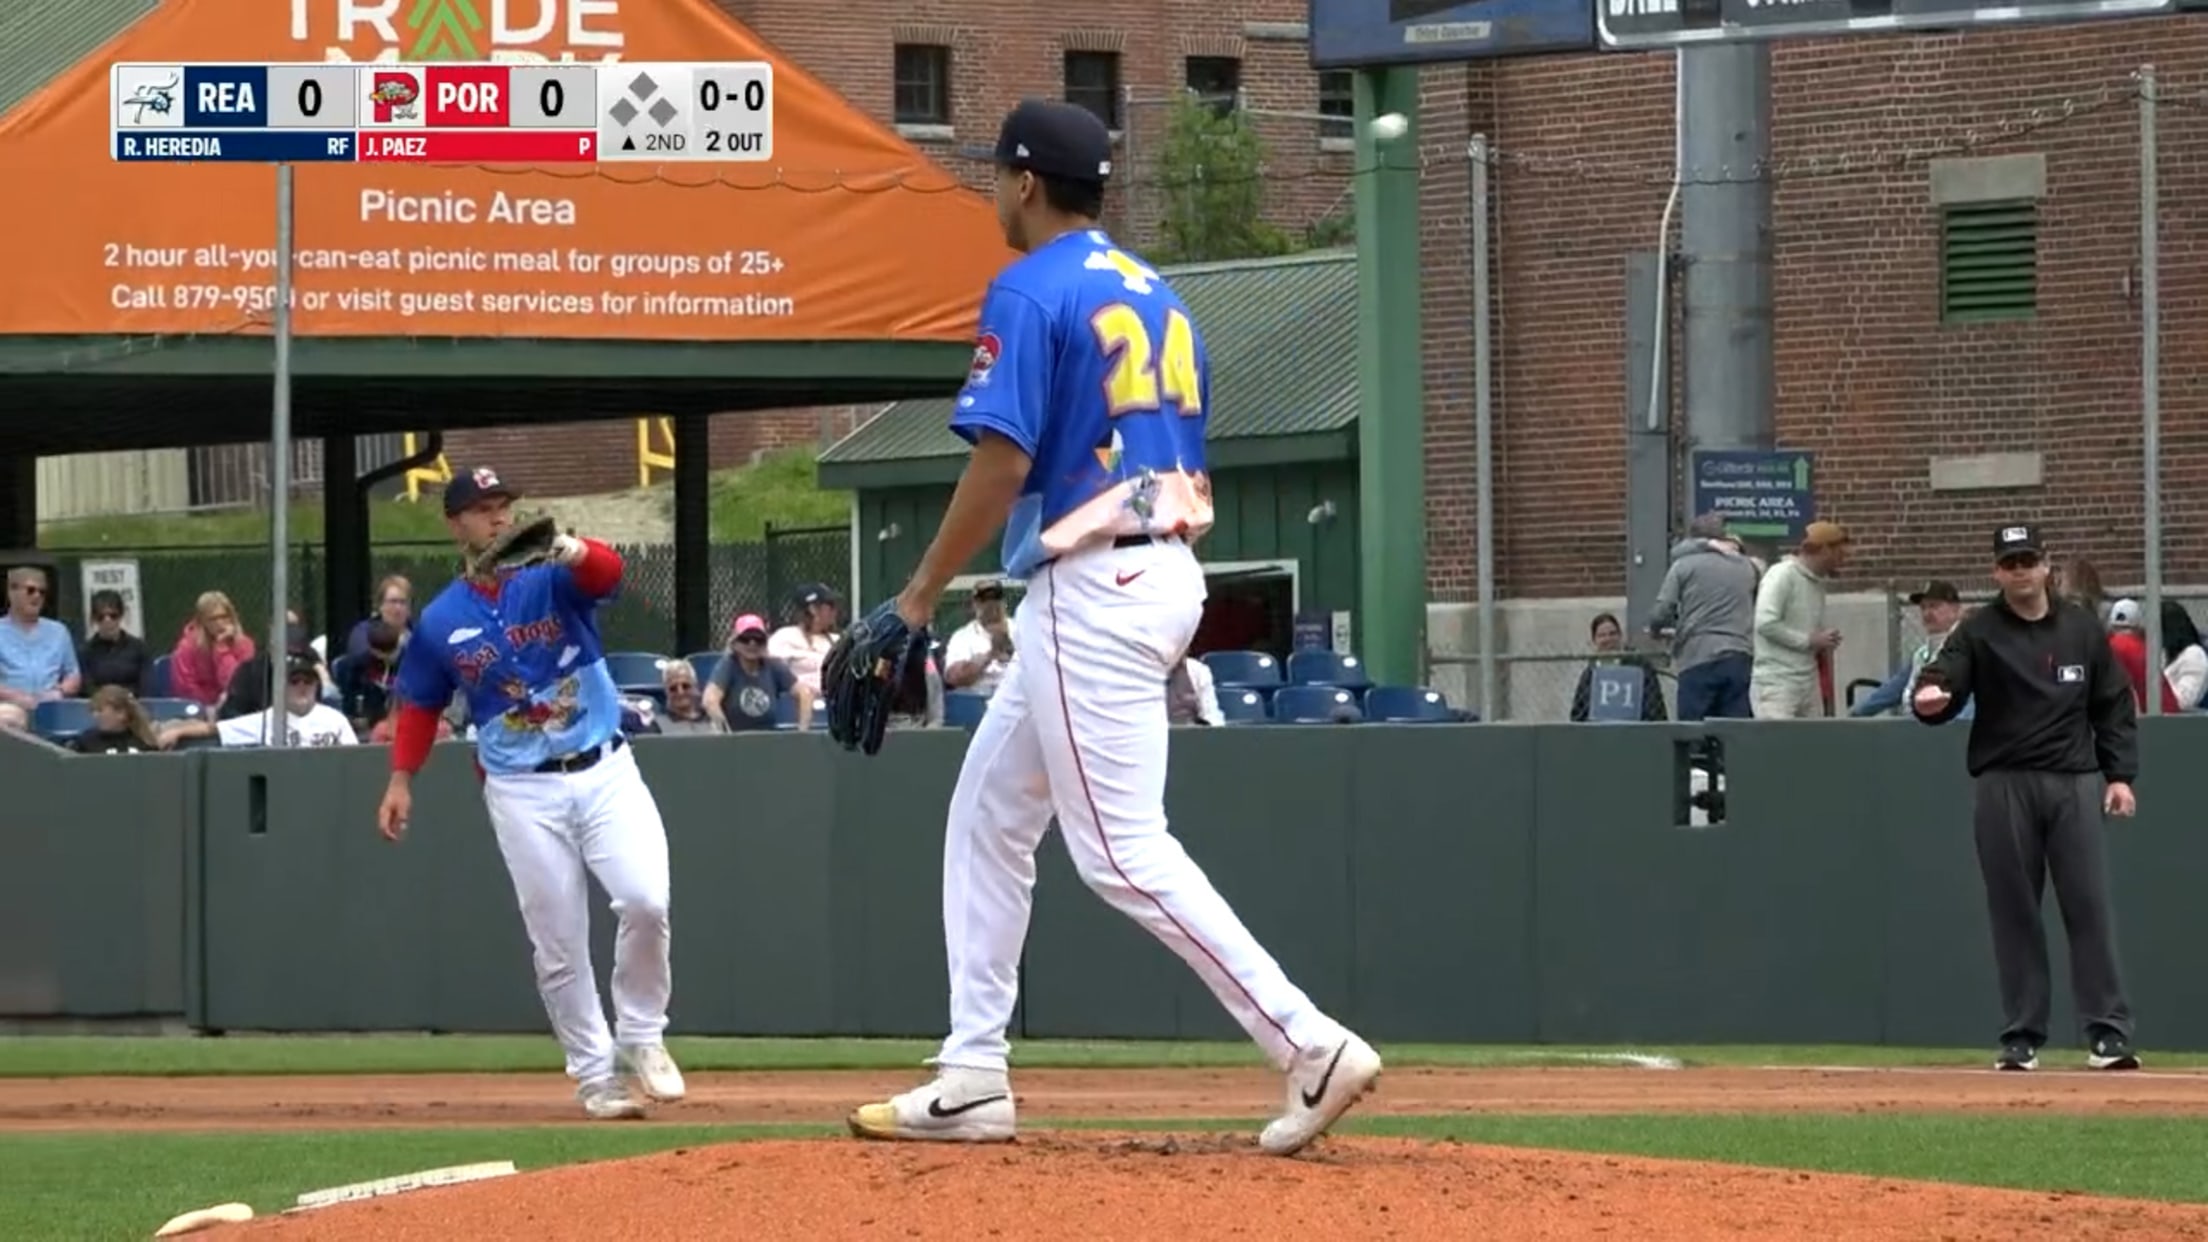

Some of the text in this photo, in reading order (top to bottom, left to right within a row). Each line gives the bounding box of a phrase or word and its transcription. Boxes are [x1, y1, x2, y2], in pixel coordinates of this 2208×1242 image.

[359, 189, 577, 225] Picnic Area
[104, 243, 119, 267] 2
[126, 243, 188, 267] hour
[408, 246, 487, 274] picnic
[493, 249, 562, 271] meal
[567, 248, 604, 273] for
[610, 254, 701, 278] groups
[706, 251, 733, 273] of
[739, 251, 785, 274] 25+
[111, 284, 167, 309] Call
[302, 290, 331, 310] or
[337, 288, 392, 311] visit
[399, 291, 475, 316] guest
[481, 291, 595, 314] services
[600, 290, 638, 314] for
[643, 291, 794, 316] information
[1089, 302, 1202, 418] 24
[1600, 680, 1634, 708] P1
